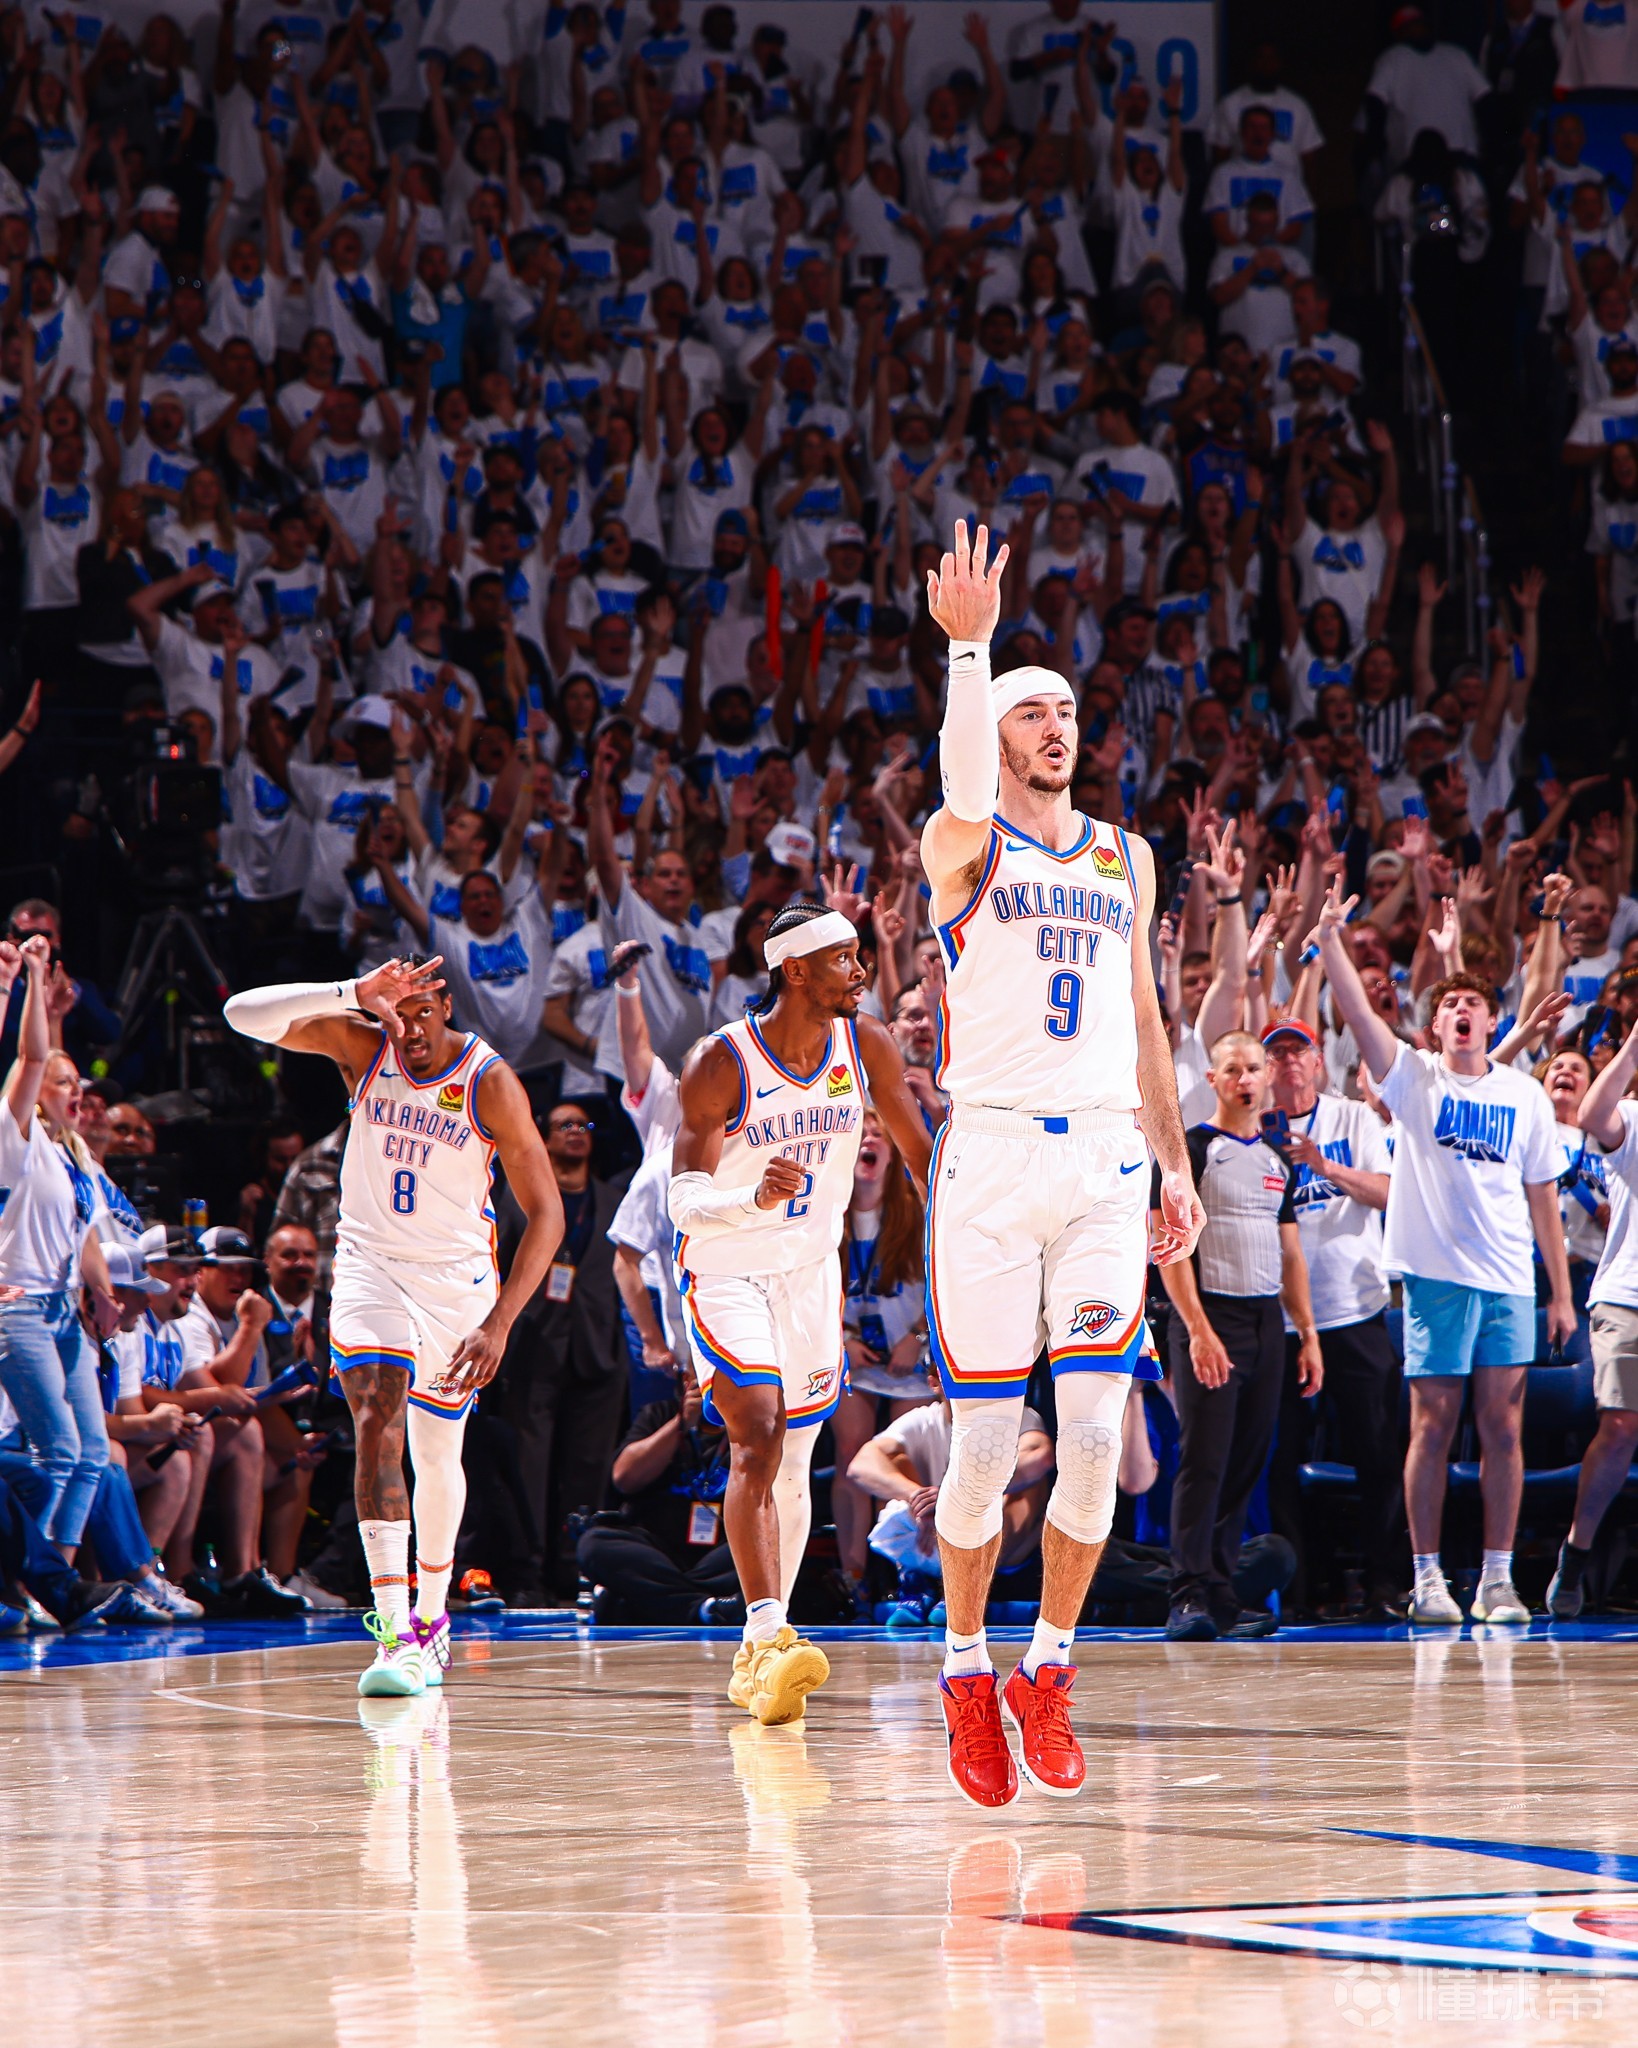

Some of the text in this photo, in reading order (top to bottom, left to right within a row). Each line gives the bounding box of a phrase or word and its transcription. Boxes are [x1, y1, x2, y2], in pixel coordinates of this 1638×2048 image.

[990, 882, 1135, 943] OKLAHOMA
[1037, 924, 1102, 967] CITY
[1044, 969, 1084, 1041] 9
[744, 1105, 861, 1148] OKLAHOMA
[383, 1132, 434, 1168] CITY
[780, 1138, 832, 1166] CITY
[390, 1167, 418, 1216] 8
[783, 1170, 816, 1221] 2
[1071, 1307, 1110, 1331] OKC
